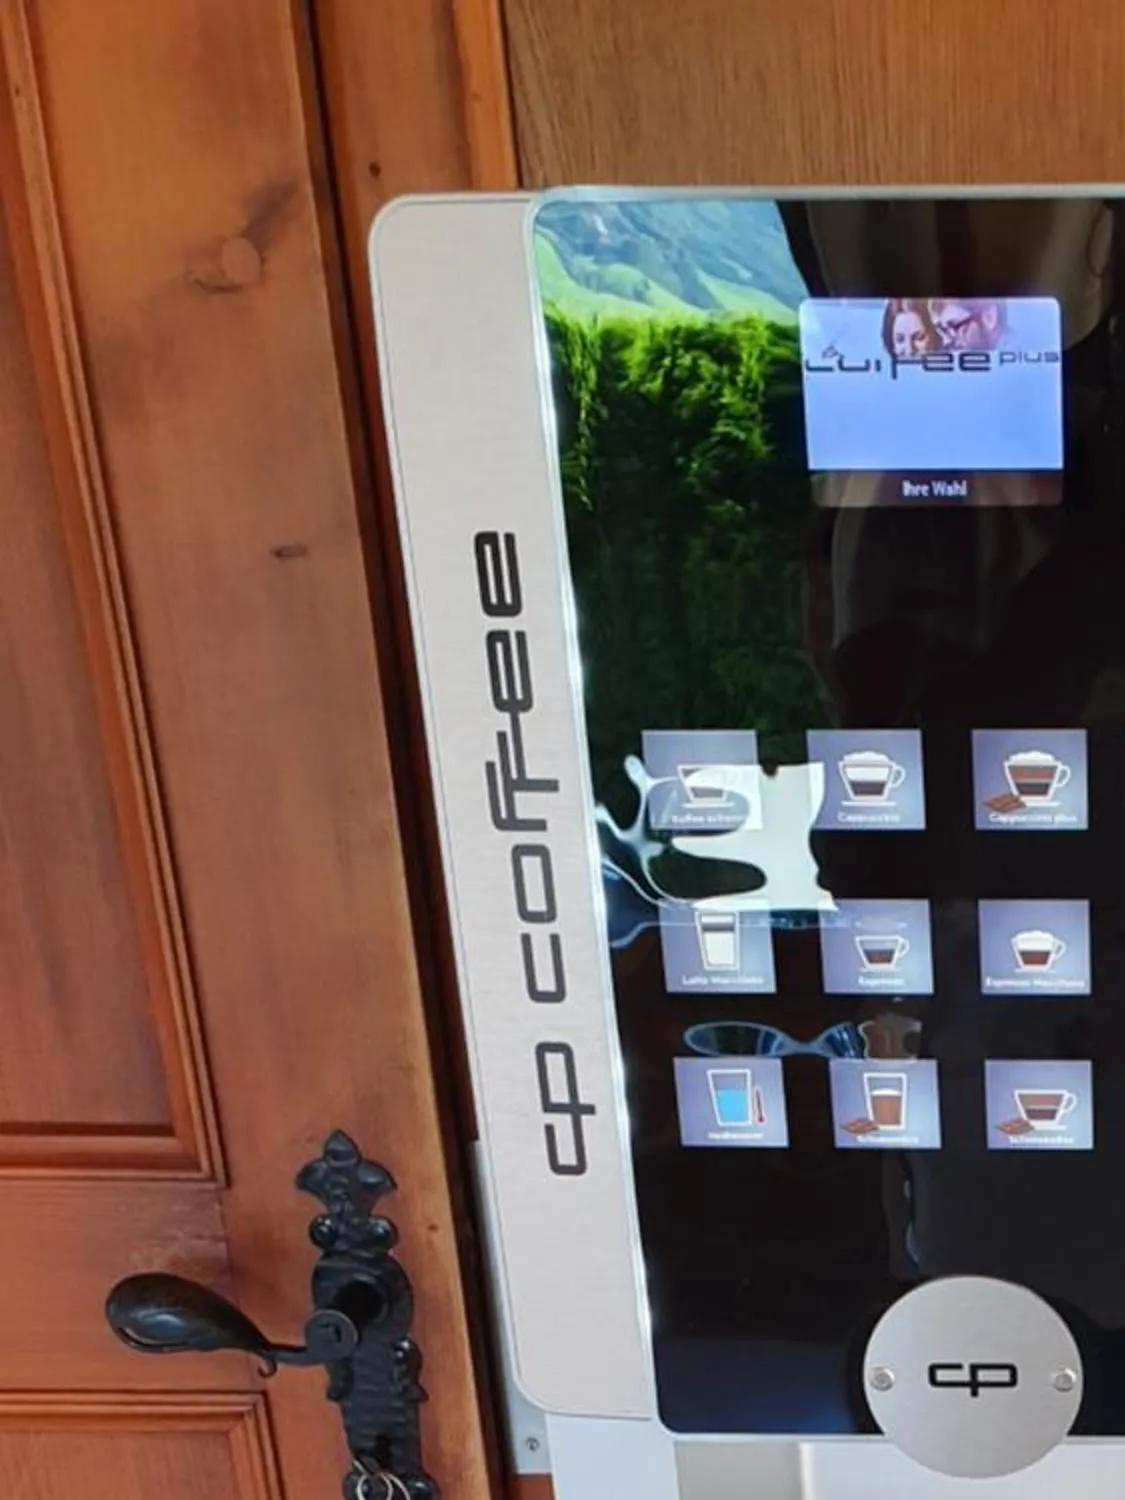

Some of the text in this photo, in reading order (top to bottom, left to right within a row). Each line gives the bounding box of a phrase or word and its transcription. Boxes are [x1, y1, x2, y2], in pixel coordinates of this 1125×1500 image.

[999, 350, 1060, 367] plus
[902, 479, 967, 497] Ihre Wahl
[473, 531, 596, 1176] cp coffee
[928, 1363, 1018, 1398] cp
